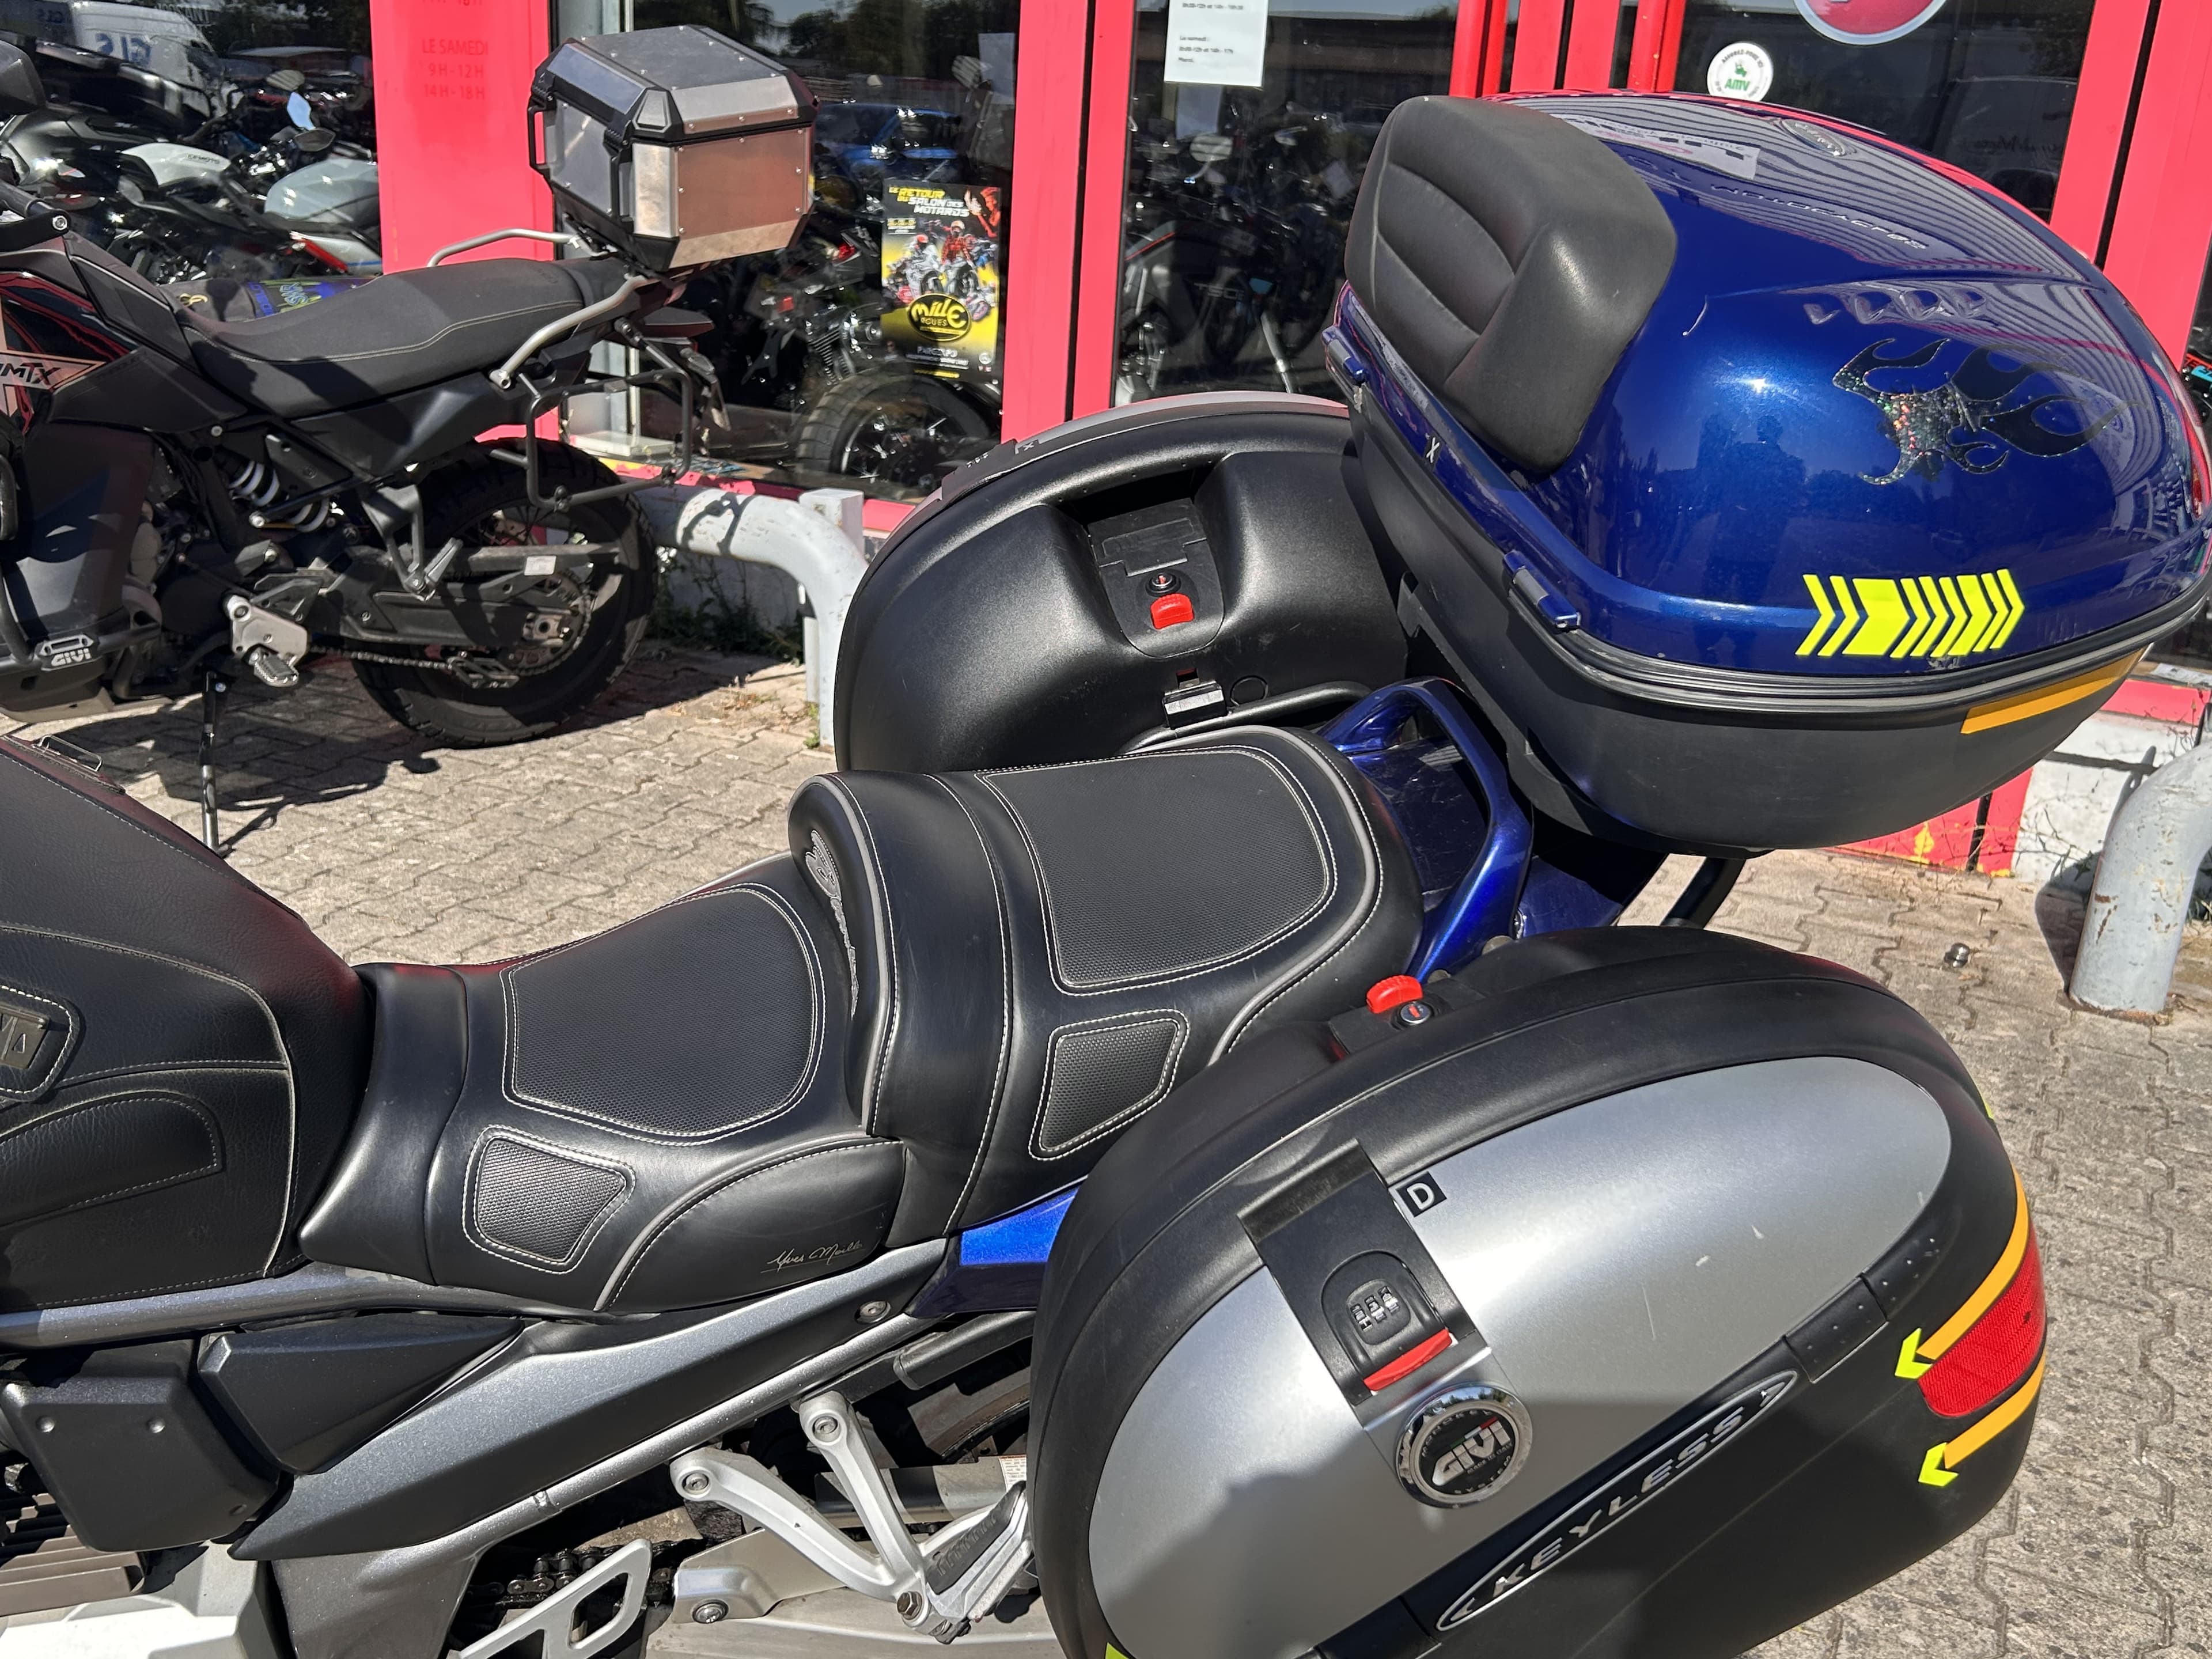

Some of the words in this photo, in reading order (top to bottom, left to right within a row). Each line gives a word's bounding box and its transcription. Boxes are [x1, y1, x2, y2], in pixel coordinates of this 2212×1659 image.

[422, 39, 436, 54] LE
[439, 39, 488, 56] SAMEDI
[898, 188, 945, 199] RETOUR
[908, 196, 946, 207] SALON
[914, 206, 970, 217] MOTARDS
[51, 648, 91, 666] GIVI
[1407, 1183, 1435, 1210] D
[767, 1248, 804, 1272] Yves
[1432, 1420, 1511, 1486] GIVI
[1493, 1406, 1745, 1598] KEYLESS
